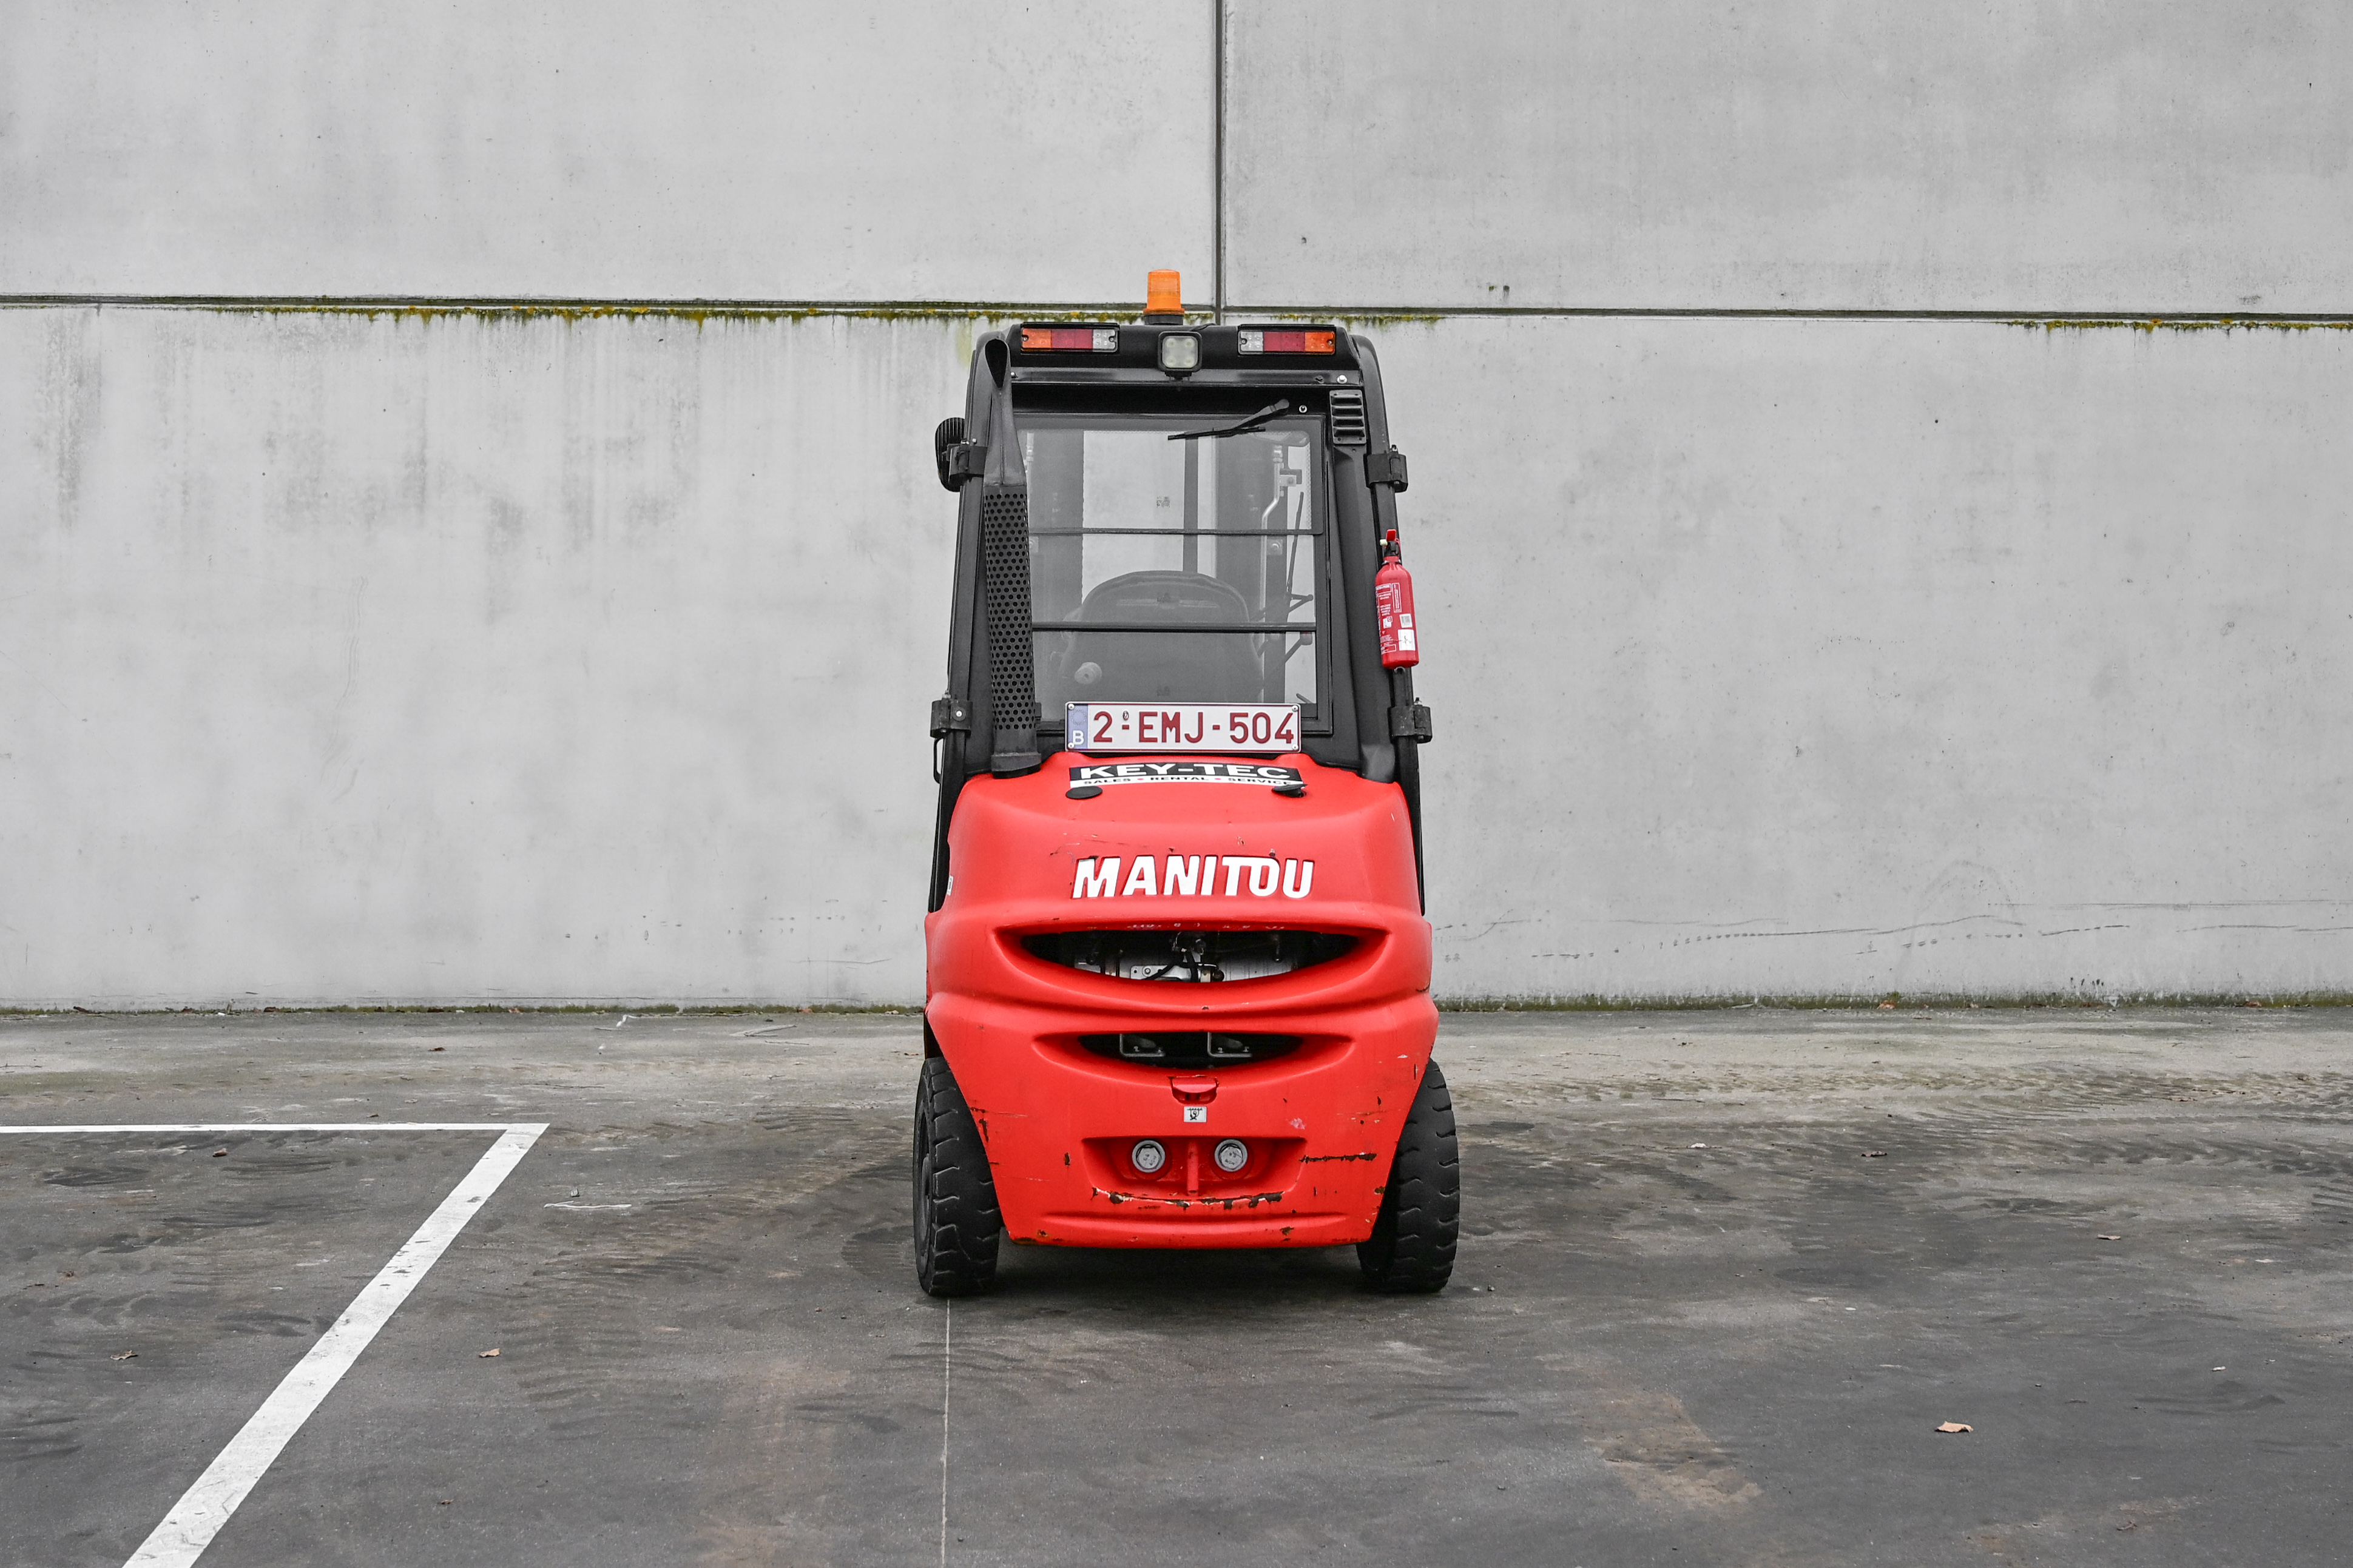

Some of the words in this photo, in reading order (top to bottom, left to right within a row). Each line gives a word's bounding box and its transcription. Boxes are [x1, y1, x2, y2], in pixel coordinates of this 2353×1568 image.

[1072, 730, 1084, 745] B
[1080, 763, 1291, 779] KEY-TEC
[1072, 855, 1314, 899] MANITOU
